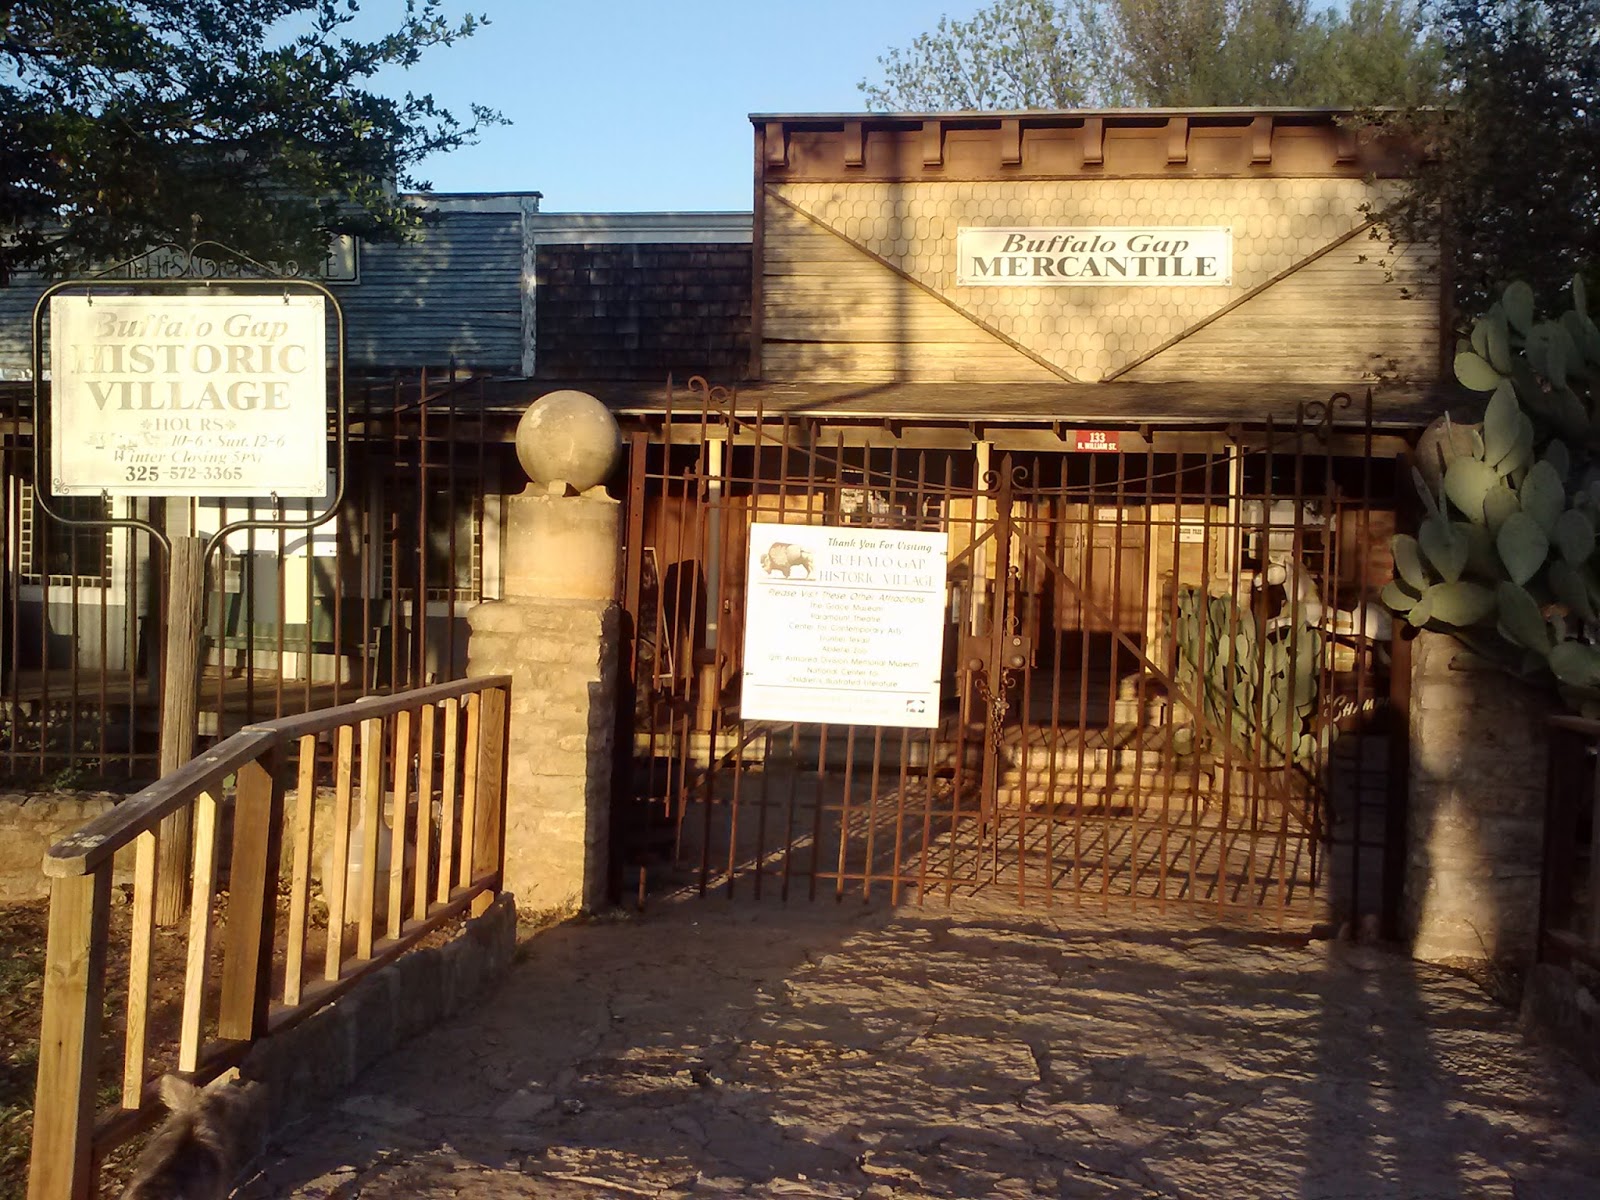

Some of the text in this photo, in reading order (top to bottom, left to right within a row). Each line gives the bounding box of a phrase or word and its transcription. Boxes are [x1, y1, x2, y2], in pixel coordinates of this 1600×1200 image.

[1000, 233, 1190, 256] Buffalo Gap
[971, 256, 1217, 277] MERCANTILE
[223, 314, 289, 342] Gap
[70, 344, 306, 374] HISTORIC
[84, 381, 291, 411] VILLAGE
[155, 418, 224, 431] HOURS
[1090, 432, 1105, 443] 133
[125, 466, 243, 482] 325-572-3365
[828, 537, 933, 553] Thank You For Visiting
[831, 553, 895, 568] BUFFALO
[819, 570, 875, 584] HISTORIC
